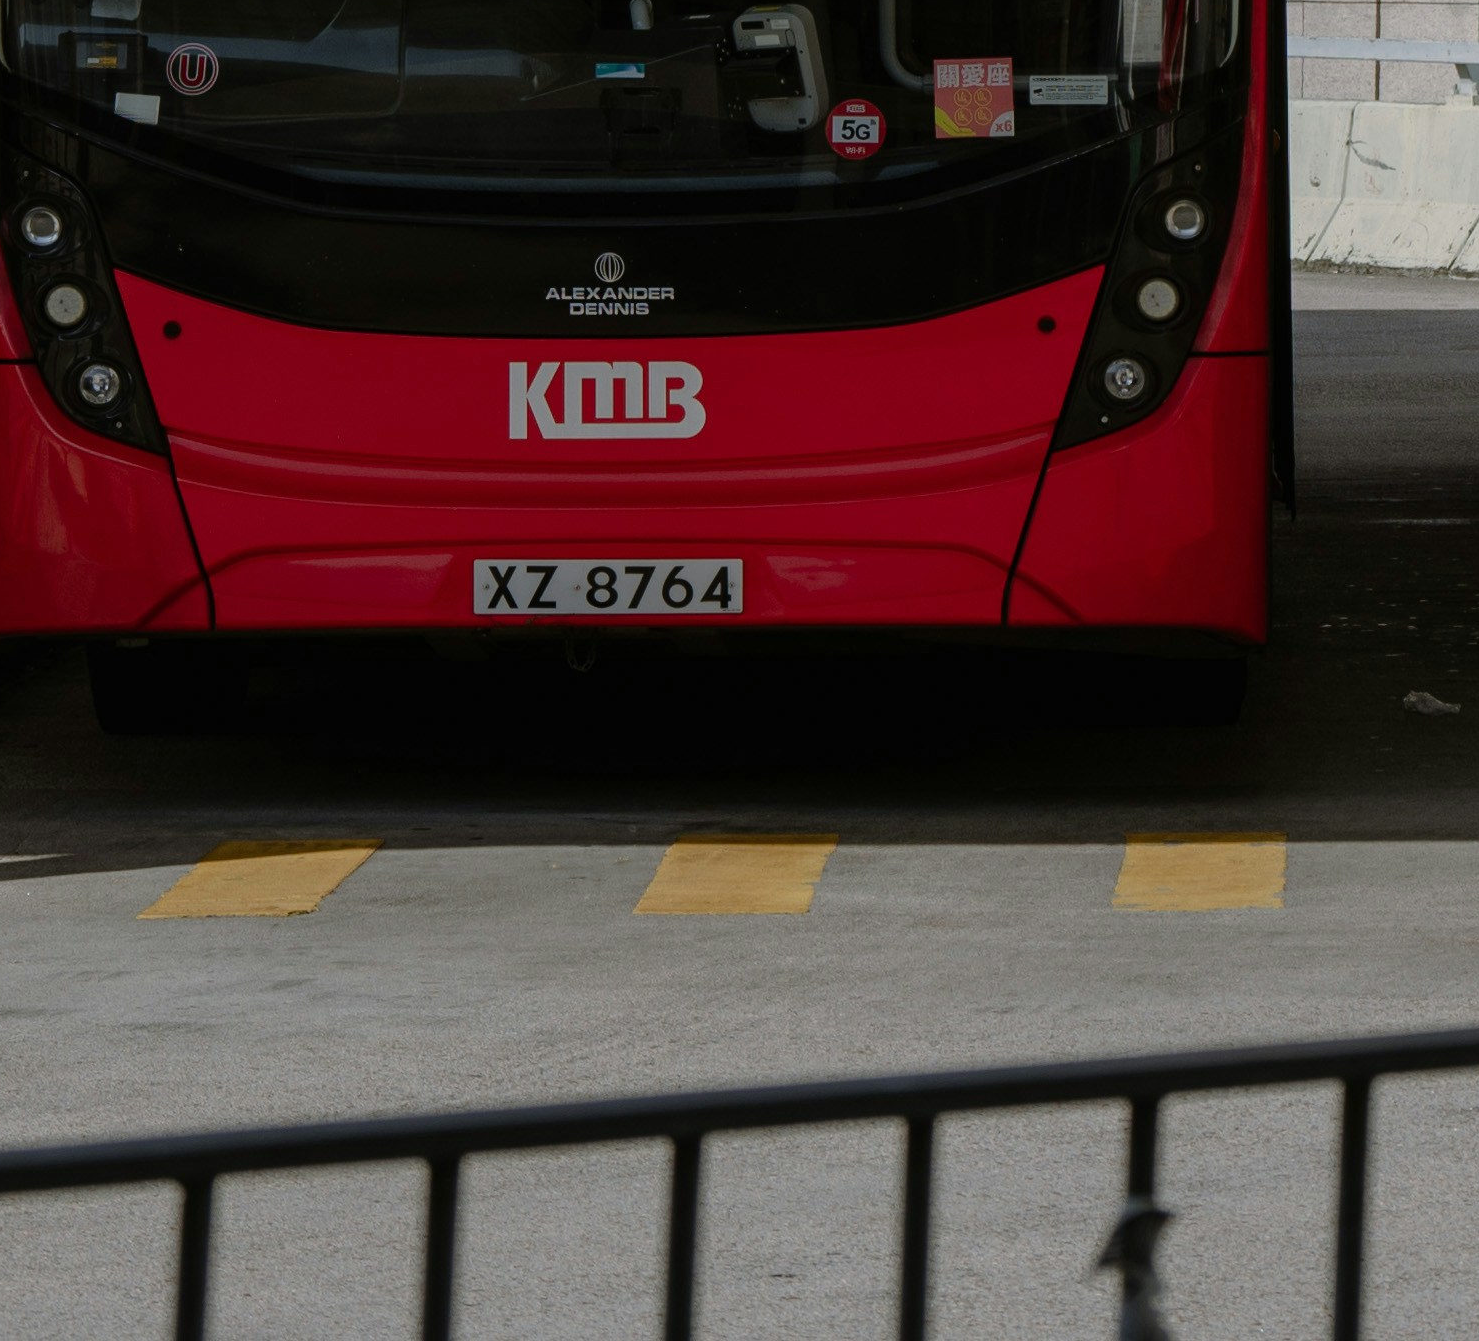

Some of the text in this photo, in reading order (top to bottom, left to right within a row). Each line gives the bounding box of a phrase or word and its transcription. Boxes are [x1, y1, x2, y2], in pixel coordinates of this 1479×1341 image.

[936, 62, 1010, 89] 關愛座
[841, 119, 871, 141] 5G
[545, 286, 675, 300] ALEXANDER
[569, 302, 650, 316] DENNIS
[509, 360, 707, 440] KMB
[487, 565, 732, 609] XZ 8764
